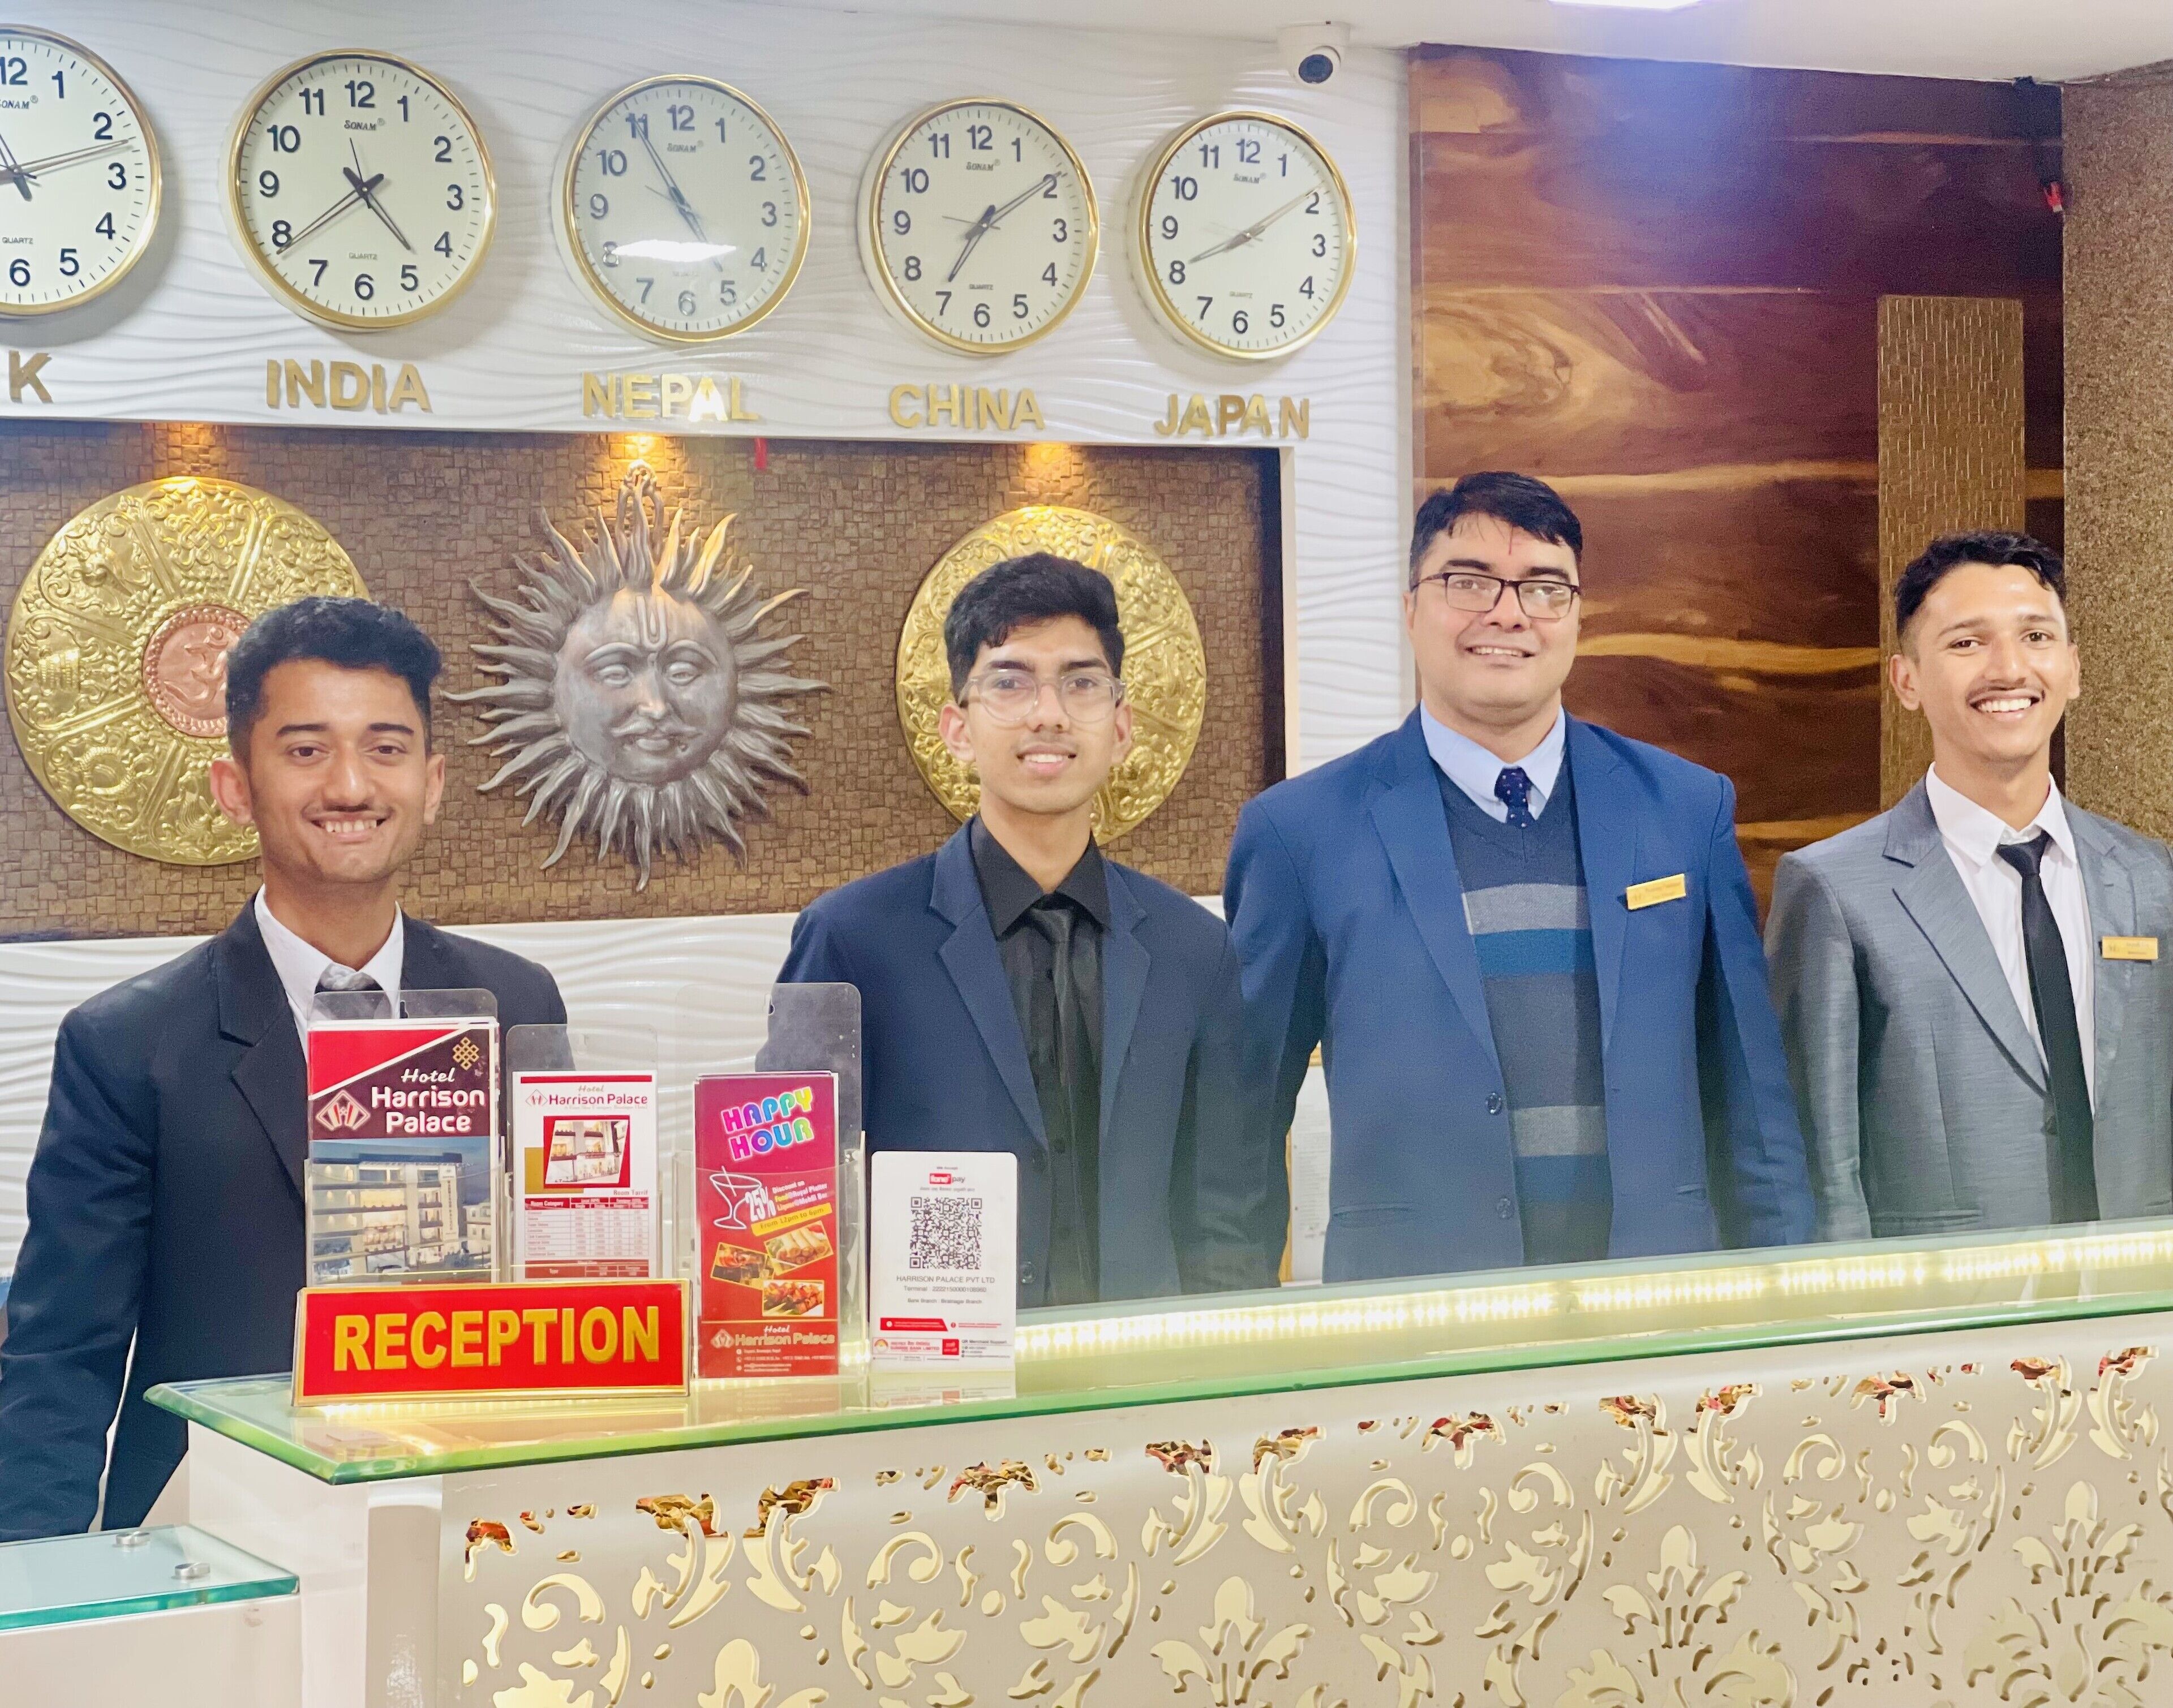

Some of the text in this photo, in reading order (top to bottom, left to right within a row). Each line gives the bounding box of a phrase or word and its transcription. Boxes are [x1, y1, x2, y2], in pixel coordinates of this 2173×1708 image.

[0, 57, 28, 85] 12
[51, 71, 64, 98] 1
[345, 80, 375, 108] 12
[299, 88, 324, 115] 11
[397, 96, 408, 122] 1
[93, 112, 113, 140] 2
[626, 113, 649, 140] 11
[667, 105, 695, 131] 12
[715, 118, 725, 143] 1
[267, 125, 300, 153] 10
[434, 136, 452, 163] 2
[928, 134, 949, 158] 11
[967, 125, 993, 150] 12
[1011, 137, 1020, 162] 1
[596, 150, 627, 176] 10
[1199, 144, 1219, 169] 11
[1236, 139, 1260, 164] 12
[108, 162, 127, 190] 3
[750, 156, 766, 181] 2
[1278, 154, 1286, 177] 1
[259, 170, 280, 198] 9
[901, 168, 929, 193] 10
[1043, 174, 1058, 199] 2
[1171, 176, 1197, 201] 10
[446, 184, 464, 210] 3
[590, 194, 608, 220] 9
[1305, 192, 1319, 214] 2
[96, 212, 116, 240] 4
[762, 202, 776, 226] 3
[894, 210, 911, 235] 9
[272, 220, 293, 249] 8
[1053, 218, 1067, 242] 3
[1162, 216, 1178, 240] 9
[434, 231, 453, 258] 4
[602, 241, 619, 267] 8
[1312, 234, 1325, 257] 3
[59, 248, 79, 277] 5
[751, 247, 767, 272] 4
[904, 256, 921, 281] 8
[10, 259, 31, 287] 6
[309, 259, 328, 287] 7
[401, 265, 419, 291] 5
[1042, 263, 1058, 286] 4
[1169, 260, 1186, 285] 8
[355, 274, 374, 300] 6
[637, 278, 653, 303] 7
[720, 281, 737, 306] 5
[1299, 276, 1314, 299] 4
[678, 290, 696, 316] 6
[936, 291, 951, 316] 7
[974, 303, 990, 328] 6
[1014, 294, 1028, 319] 5
[1197, 296, 1213, 320] 7
[1232, 310, 1248, 334] 6
[1270, 304, 1285, 328] 5
[265, 359, 432, 412] INDIA
[582, 373, 759, 422] NEPAL
[890, 384, 1045, 430] CHINA
[1154, 393, 1310, 438] JAPAN
[401, 1066, 456, 1083] Hotel
[371, 1085, 485, 1109] Harrison
[549, 1094, 648, 1105] Harrison Palace
[722, 1086, 813, 1133] HAPPY
[385, 1111, 471, 1134] Palace
[728, 1117, 814, 1161] HOUR
[745, 1186, 776, 1221] 25%
[760, 1220, 778, 1229] From
[779, 1215, 798, 1223] 12pm
[333, 1305, 659, 1371] RECEPTION
[735, 1332, 835, 1346] Harrison Palace
